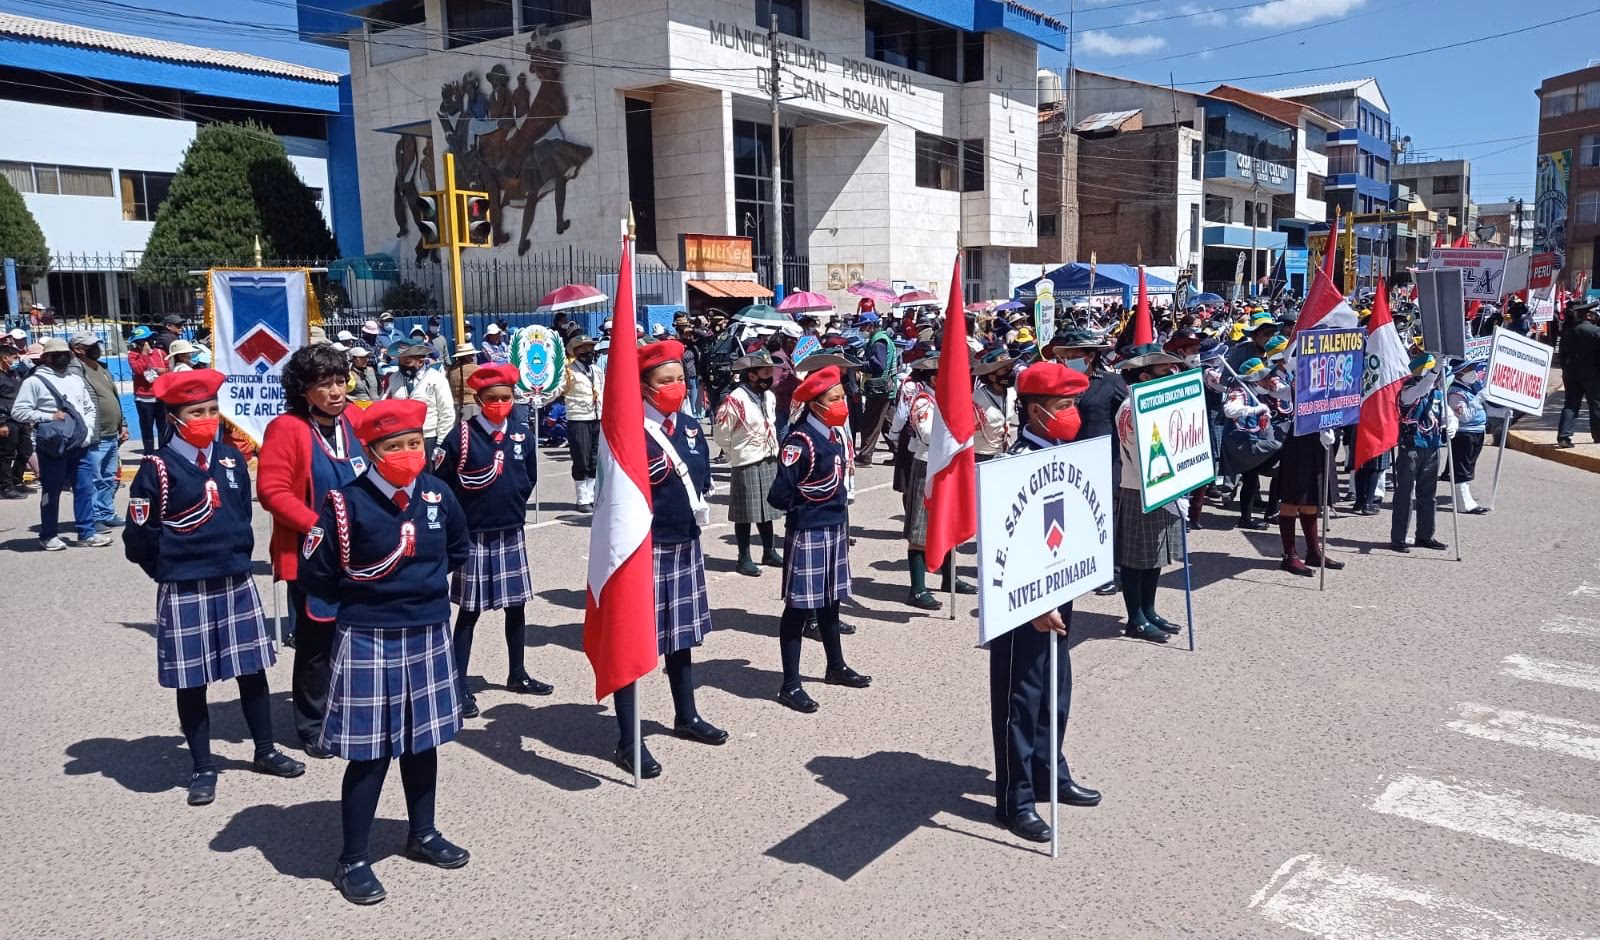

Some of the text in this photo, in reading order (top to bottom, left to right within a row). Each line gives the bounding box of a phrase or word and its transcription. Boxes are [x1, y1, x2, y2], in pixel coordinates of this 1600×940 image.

[842, 57, 916, 95] PROVINCIAL
[793, 75, 826, 103] SAN
[842, 88, 889, 117] ROMAN
[1301, 332, 1363, 355] I.E. TALENTOS
[224, 371, 263, 384] NSTITUCIÓN
[230, 386, 287, 399] SAN GINE
[1491, 362, 1544, 400] AMERICAN NOBEL
[235, 400, 284, 416] DE ARLÉ
[1297, 401, 1313, 416] SOLO
[1313, 398, 1329, 413] PARA
[1169, 407, 1206, 456] Bethel
[1176, 451, 1210, 472] CHRISTIAN SCHOOL
[992, 454, 1108, 588] I.E. SAN GINÉS DE ARLÉS
[1008, 555, 1097, 612] NIVEL PRIMARIA
